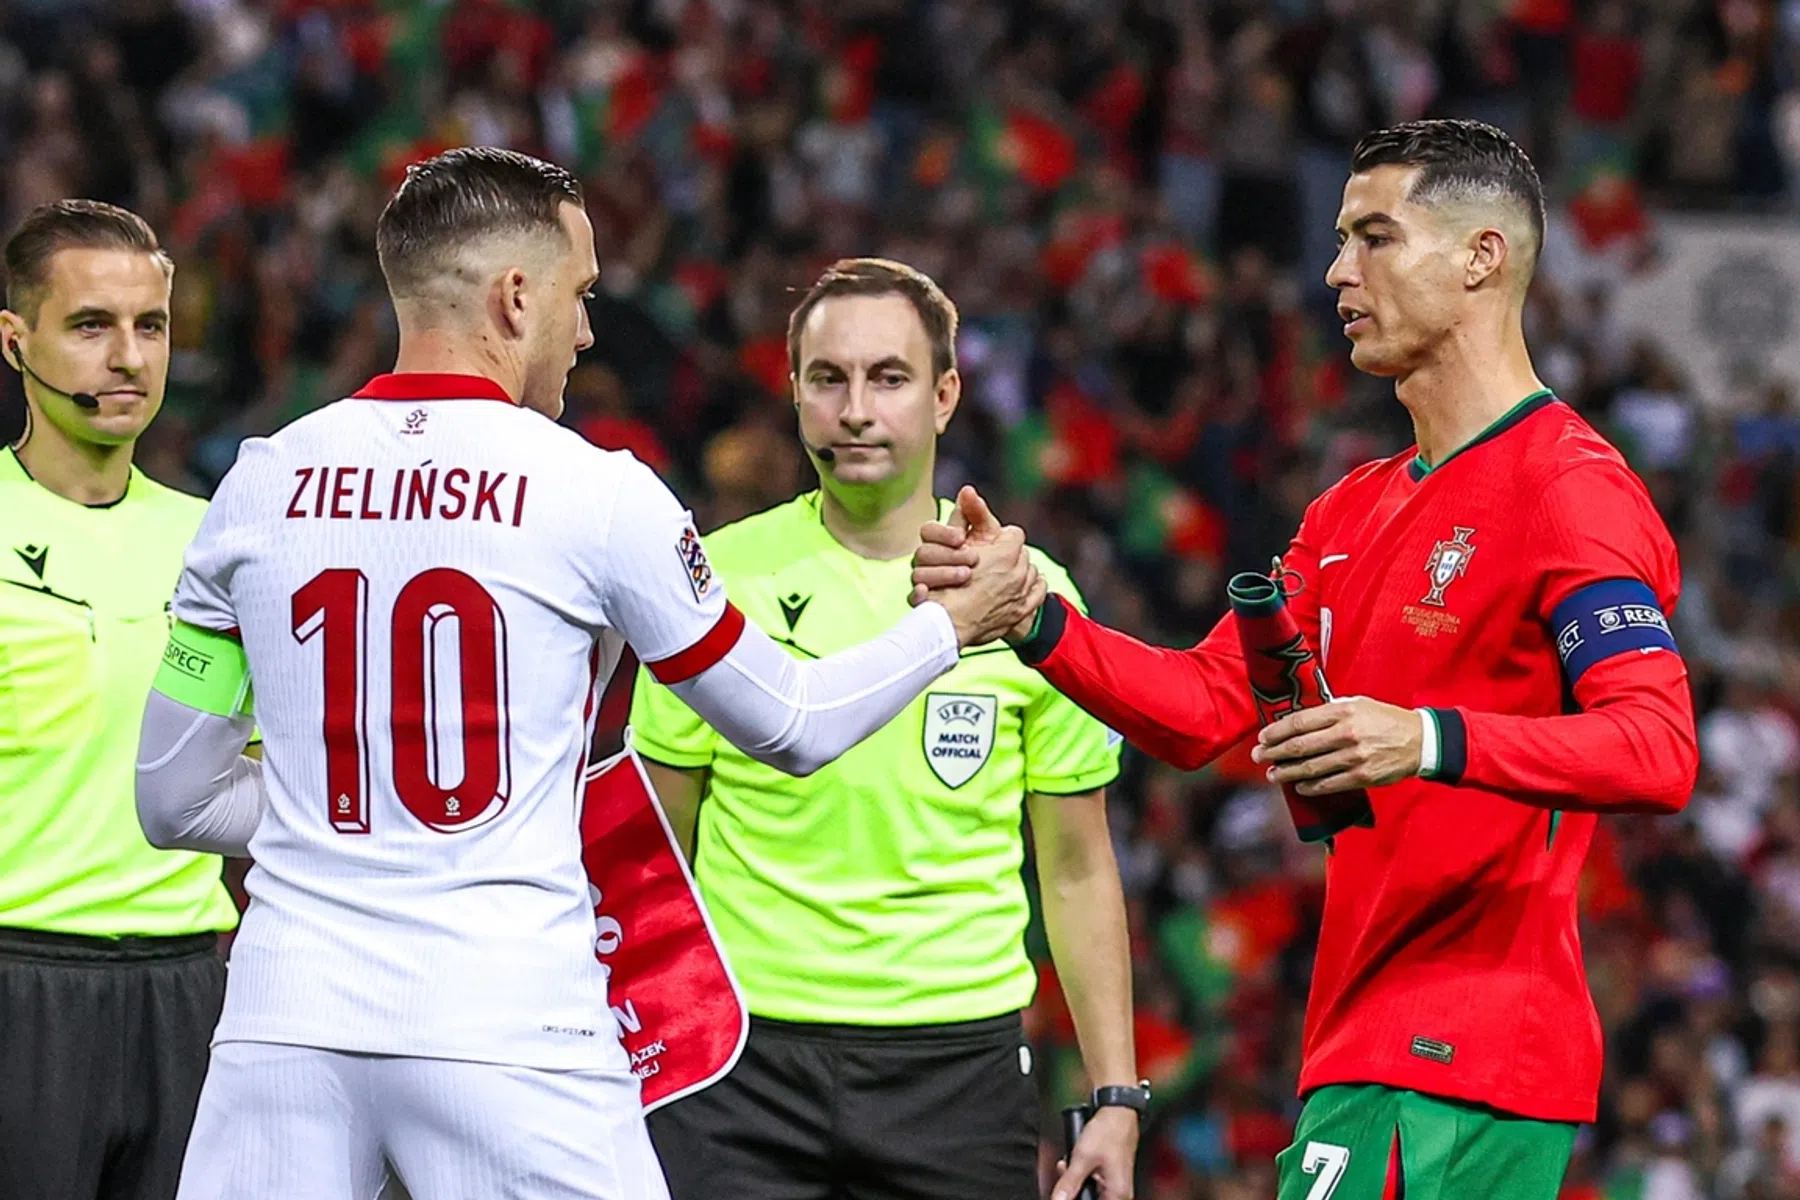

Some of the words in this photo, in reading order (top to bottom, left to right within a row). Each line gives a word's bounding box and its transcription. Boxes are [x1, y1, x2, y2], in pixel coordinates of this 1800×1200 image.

[286, 459, 528, 527] ZIELIŃSKI
[1624, 609, 1667, 631] RESP
[164, 641, 211, 674] SPECT
[291, 567, 511, 834] 10
[939, 704, 981, 722] UEFA
[932, 747, 981, 759] OFFICIAL
[938, 733, 979, 744] MATCH
[613, 999, 642, 1038] N
[1302, 1141, 1350, 1200] 7
